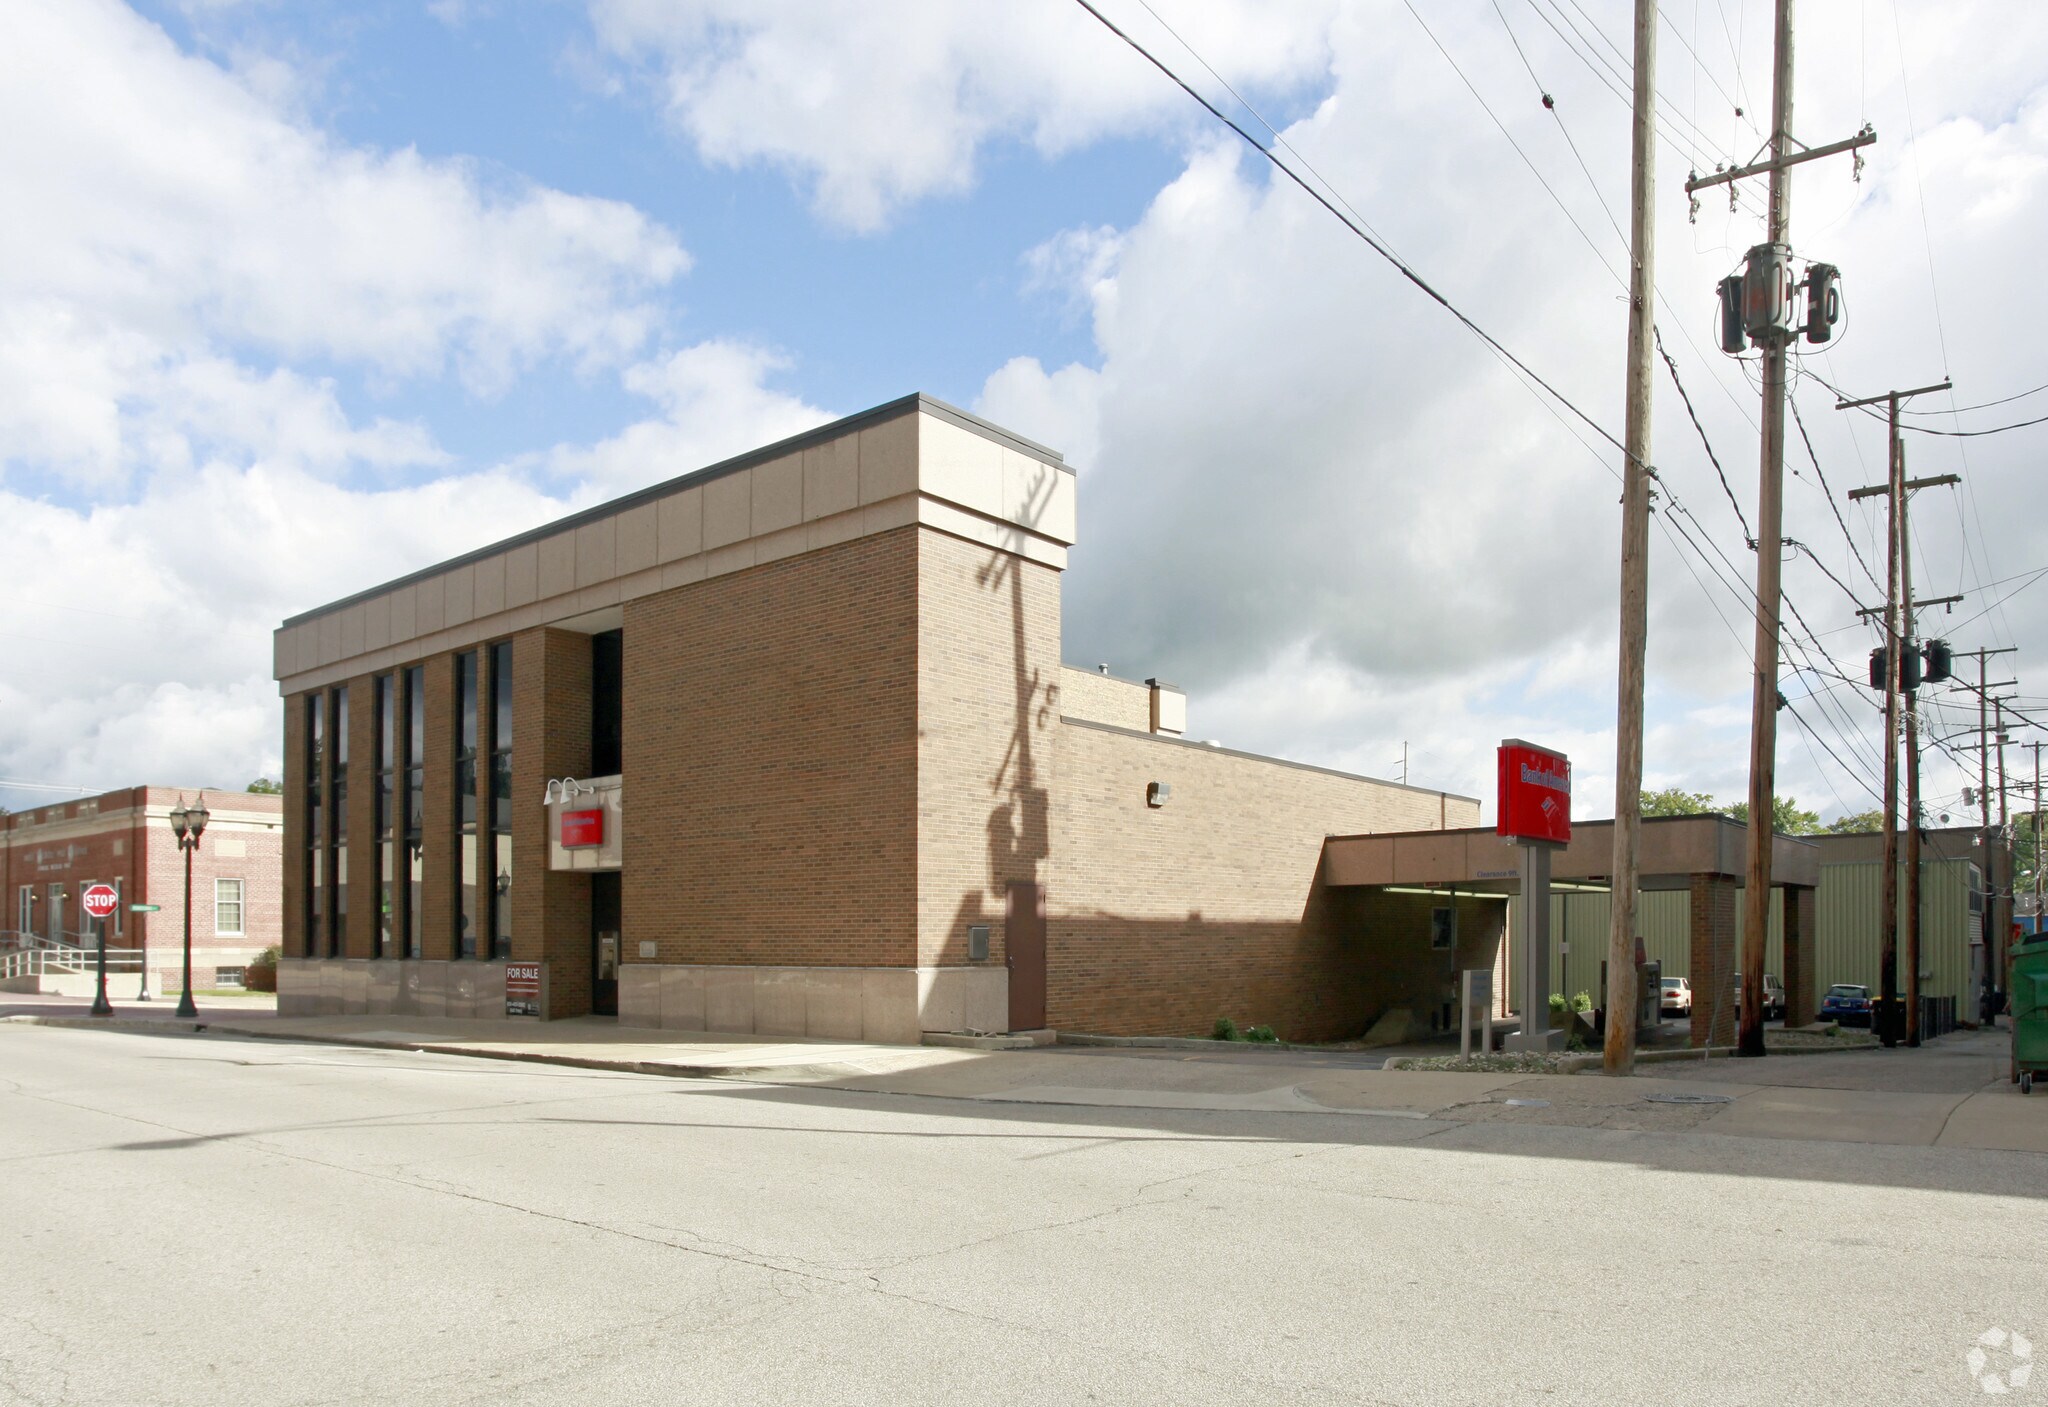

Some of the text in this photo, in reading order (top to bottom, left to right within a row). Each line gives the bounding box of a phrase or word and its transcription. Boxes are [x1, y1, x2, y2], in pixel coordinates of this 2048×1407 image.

[1521, 763, 1541, 786] Bank
[86, 894, 116, 906] STOP
[507, 967, 539, 979] FOR SALE
